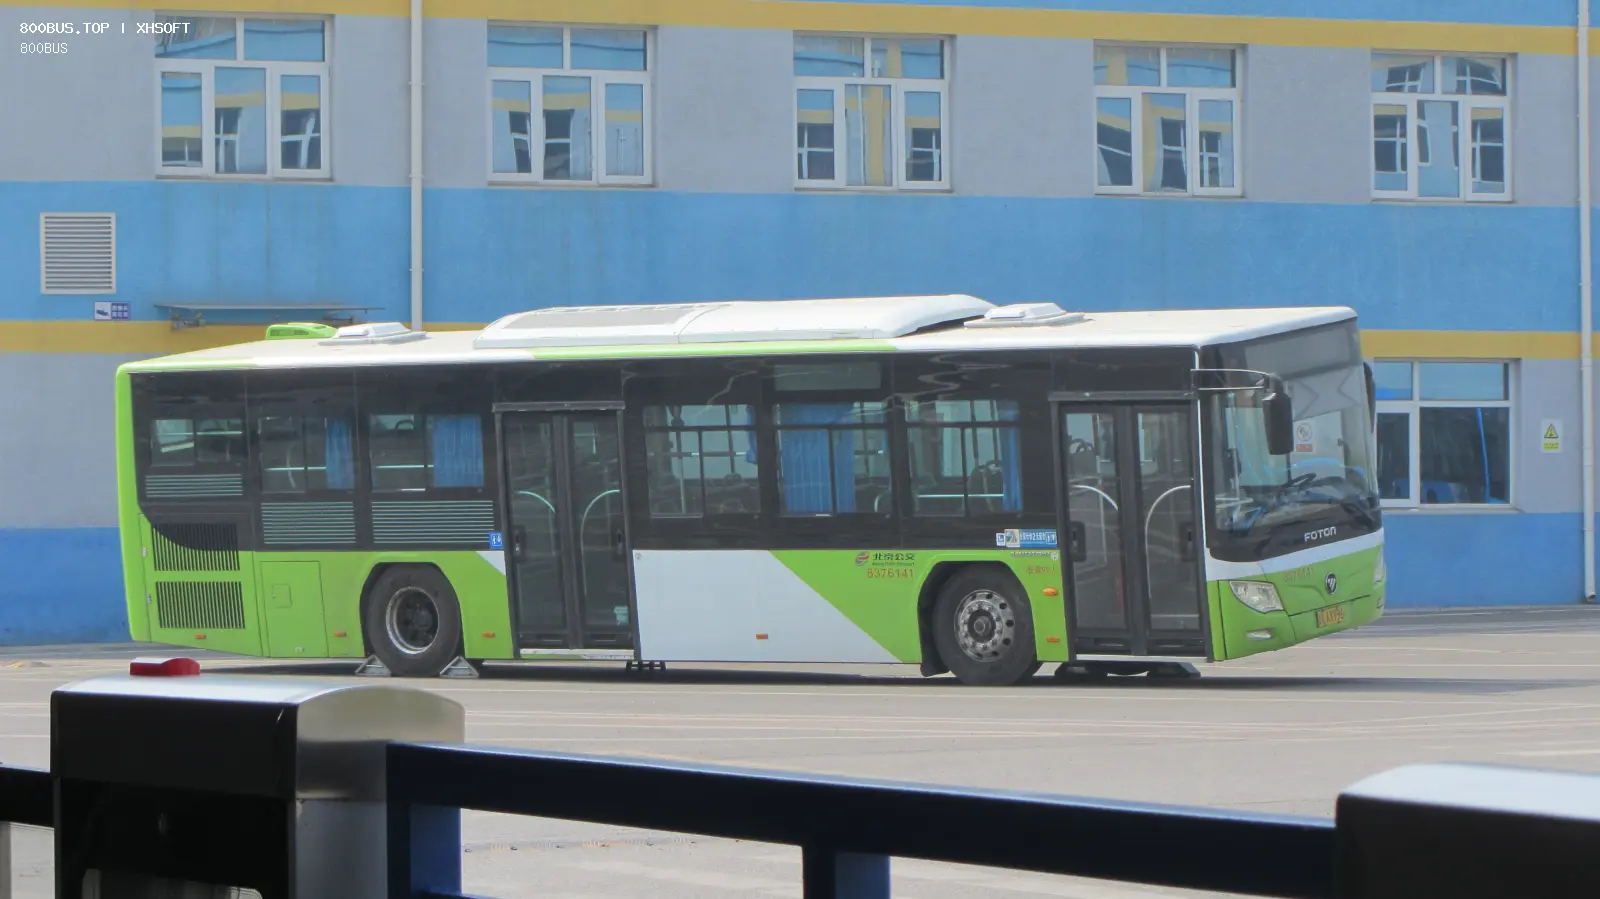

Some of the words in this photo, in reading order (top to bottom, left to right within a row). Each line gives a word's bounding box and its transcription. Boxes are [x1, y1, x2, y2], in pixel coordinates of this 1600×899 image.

[1304, 526, 1337, 542] FOTON
[872, 552, 915, 561] 北京公交
[867, 567, 914, 579] 8376141
